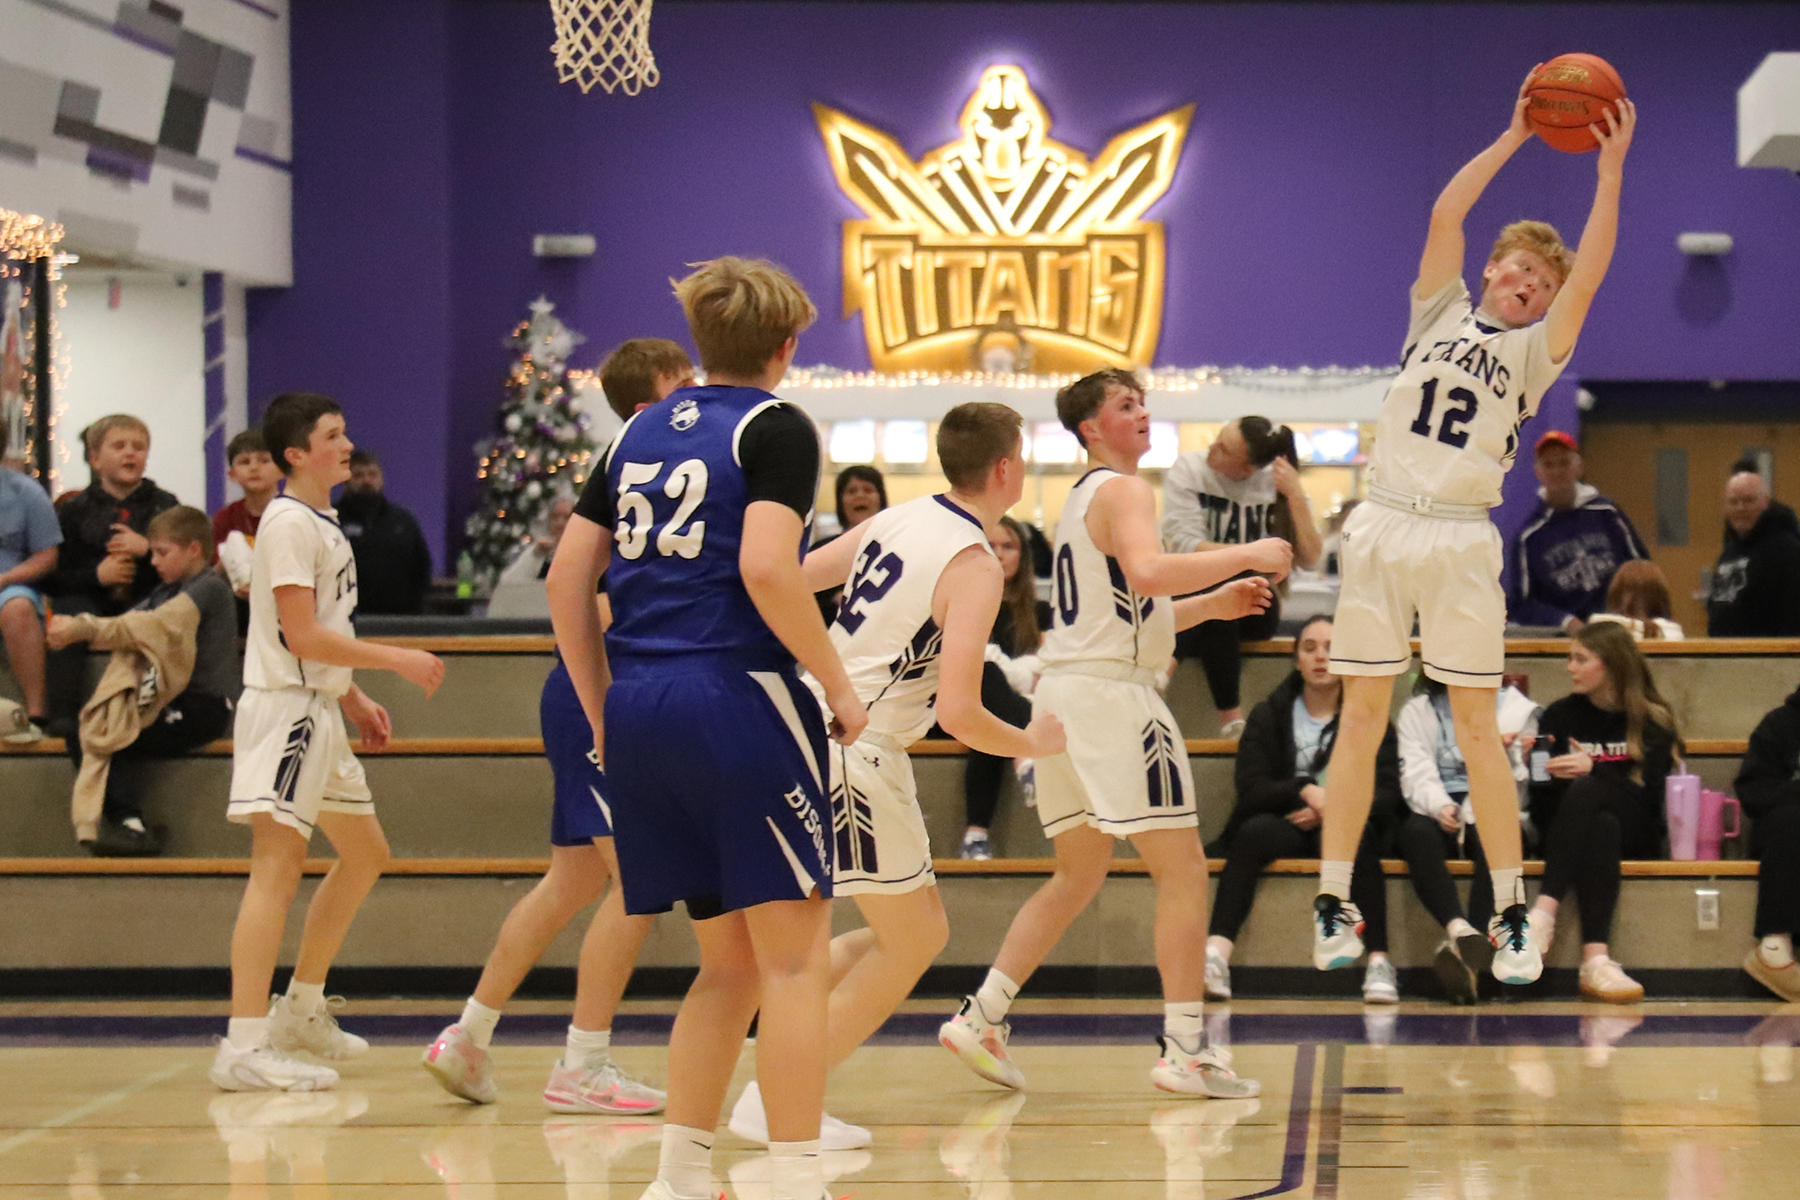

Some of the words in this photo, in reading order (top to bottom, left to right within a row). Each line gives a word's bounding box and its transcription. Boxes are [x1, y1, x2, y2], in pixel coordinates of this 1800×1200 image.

[862, 237, 1140, 353] TITANS
[1409, 376, 1478, 450] 12
[614, 458, 709, 560] 52
[836, 539, 904, 637] 22
[1048, 543, 1079, 629] 0
